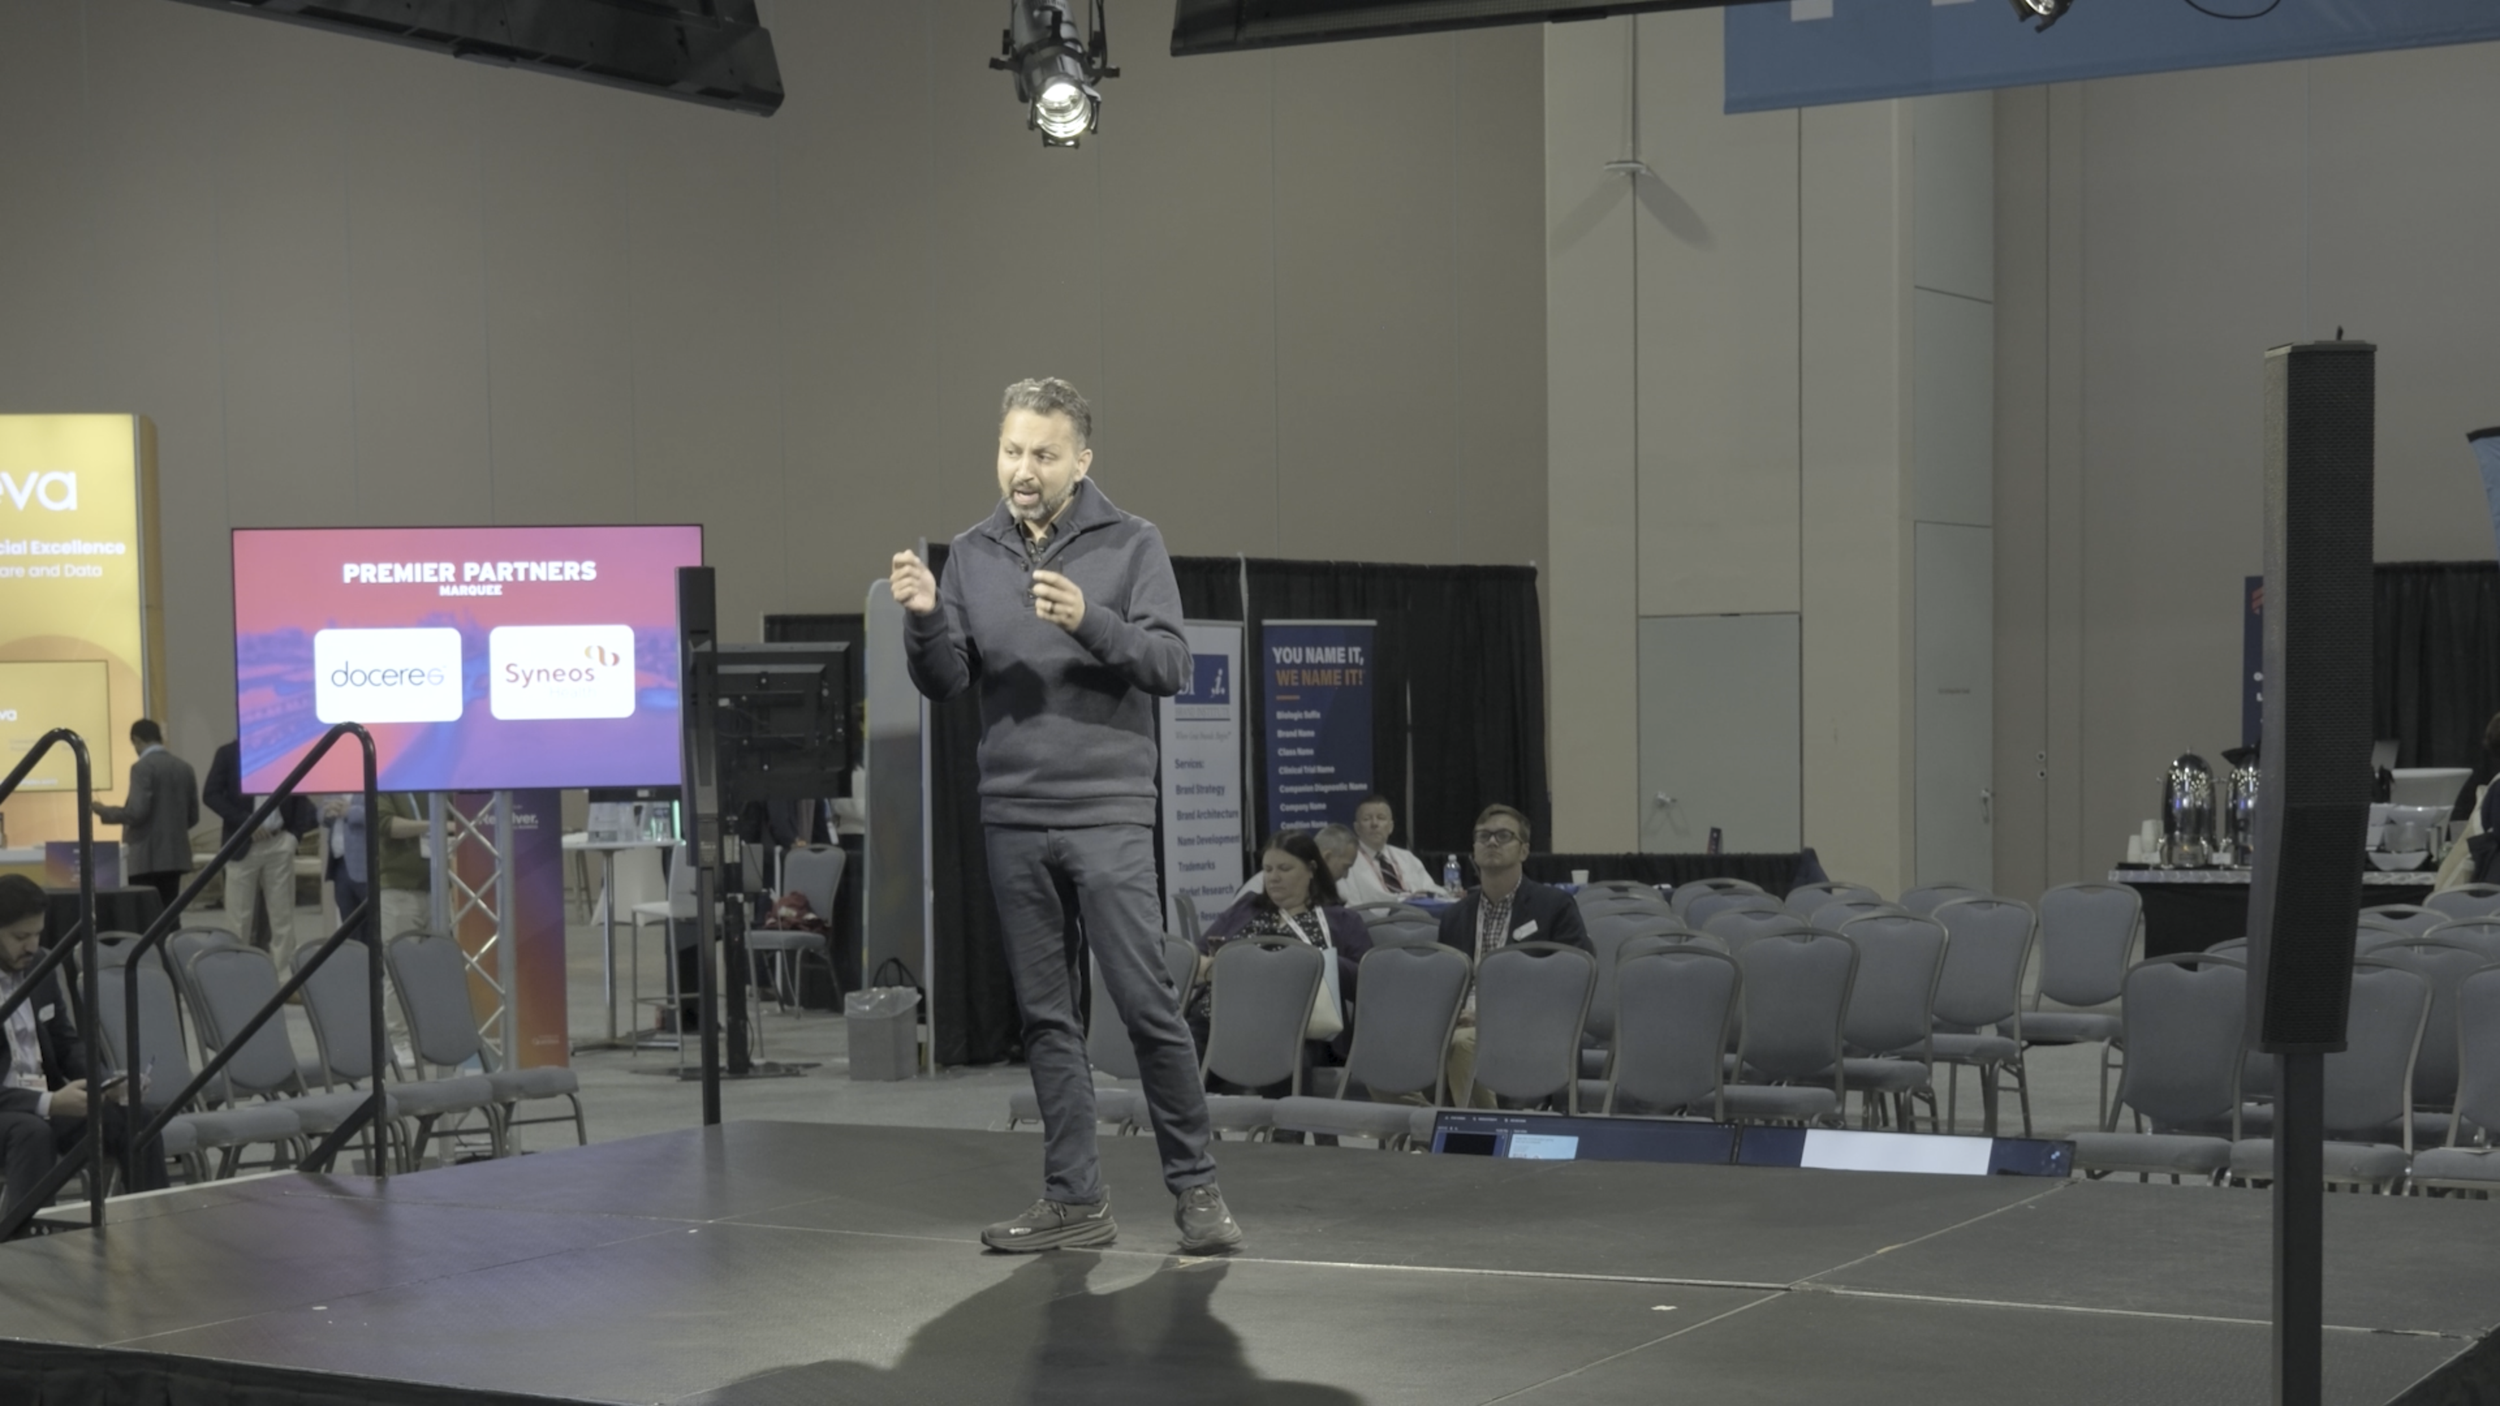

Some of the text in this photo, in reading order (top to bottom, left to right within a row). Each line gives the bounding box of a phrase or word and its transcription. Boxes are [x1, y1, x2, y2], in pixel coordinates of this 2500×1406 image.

[0, 470, 77, 511] va
[30, 539, 125, 555] Excellence
[29, 563, 60, 577] and
[64, 563, 103, 577] Data
[343, 561, 597, 584] PREMIER PARTNERS
[439, 584, 503, 597] MARQUEE
[1272, 646, 1364, 666] YOU NAME IT,
[505, 663, 595, 688] Syneos
[1275, 669, 1363, 686] WE NAME IT!
[1277, 729, 1315, 738] Brand Name
[1278, 747, 1315, 756] Class Name
[1279, 765, 1335, 775] Clinical Trial Name
[1176, 783, 1225, 797] Brand Strategy
[1314, 783, 1348, 794] Diagnostic
[1349, 782, 1368, 791] Name
[1177, 808, 1239, 820] Brand Architecture
[1280, 802, 1327, 813] Company Name
[1178, 833, 1240, 847] Name Development
[1178, 860, 1215, 872] Trademarks
[1201, 884, 1234, 896] Research
